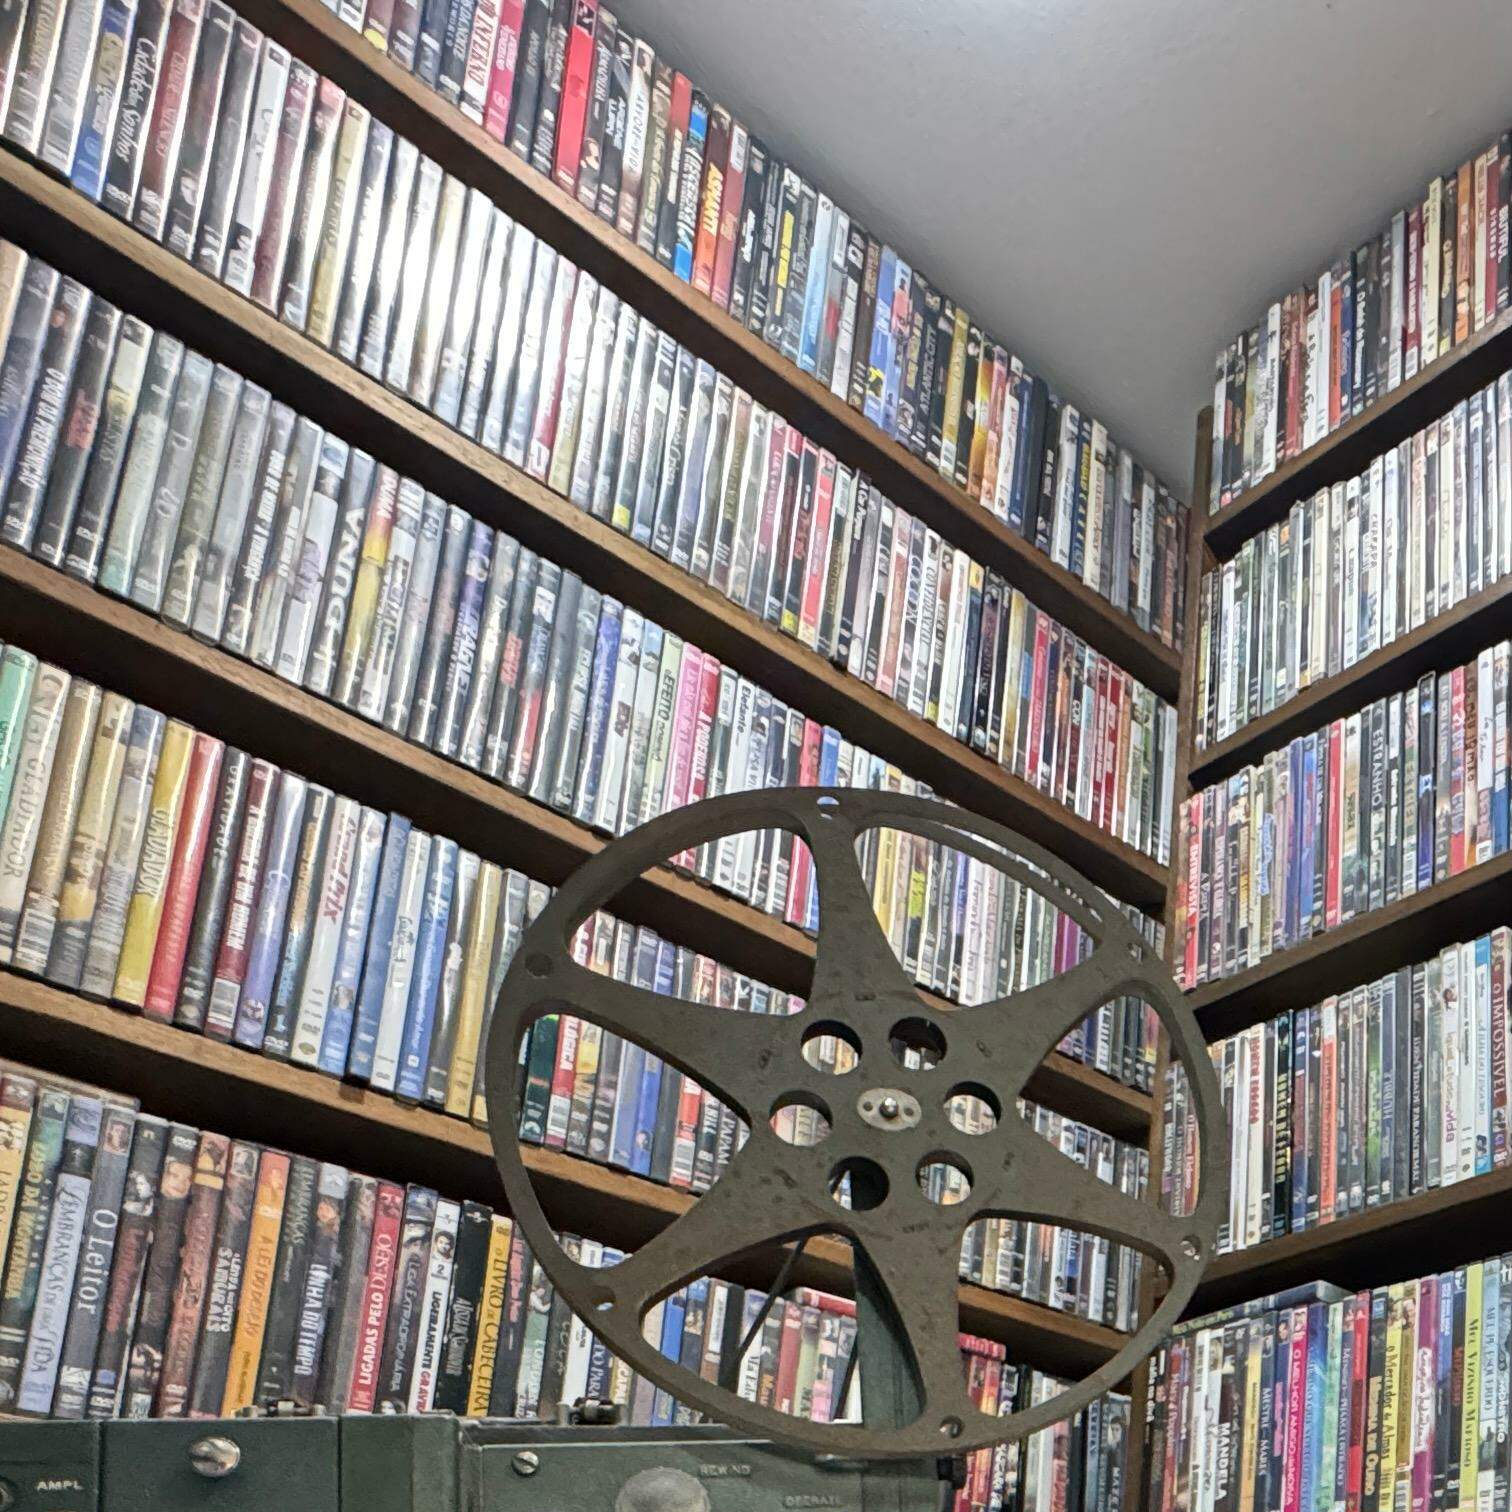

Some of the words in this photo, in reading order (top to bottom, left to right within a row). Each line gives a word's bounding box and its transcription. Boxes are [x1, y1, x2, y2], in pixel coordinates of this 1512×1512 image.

[130, 38, 156, 90] Cidade
[115, 108, 142, 165] Sonhos
[1372, 730, 1383, 807] ESTRANHO
[2, 759, 47, 879] GLADIADOR
[140, 808, 173, 897] GLADIADOR
[46, 1189, 82, 1291] LEMBRANÇAS
[92, 1208, 119, 1229] O
[77, 1234, 114, 1316] Leitor
[302, 1264, 331, 1308] LINHA
[374, 1233, 393, 1292] DESEJO
[487, 1259, 508, 1309] LIVRO
[301, 1311, 322, 1329] DO
[367, 1292, 384, 1323] PELO
[421, 1291, 443, 1370] LIGEIRAMENTE
[1468, 1319, 1480, 1344] MEU
[293, 1331, 320, 1376] TEMPO
[360, 1328, 379, 1385] LIGADAS
[472, 1322, 498, 1412] CABECEIRA
[1466, 1350, 1478, 1405] VIZINHO
[1288, 1361, 1300, 1410] MELHOR
[1287, 1413, 1298, 1453] AMIGO
[37, 1480, 83, 1491] AMPL
[701, 1463, 750, 1476] REWND
[1111, 1465, 1121, 1503] MAZE
[1215, 1422, 1231, 1499] MANDELA
[1364, 1453, 1379, 1496] OURO
